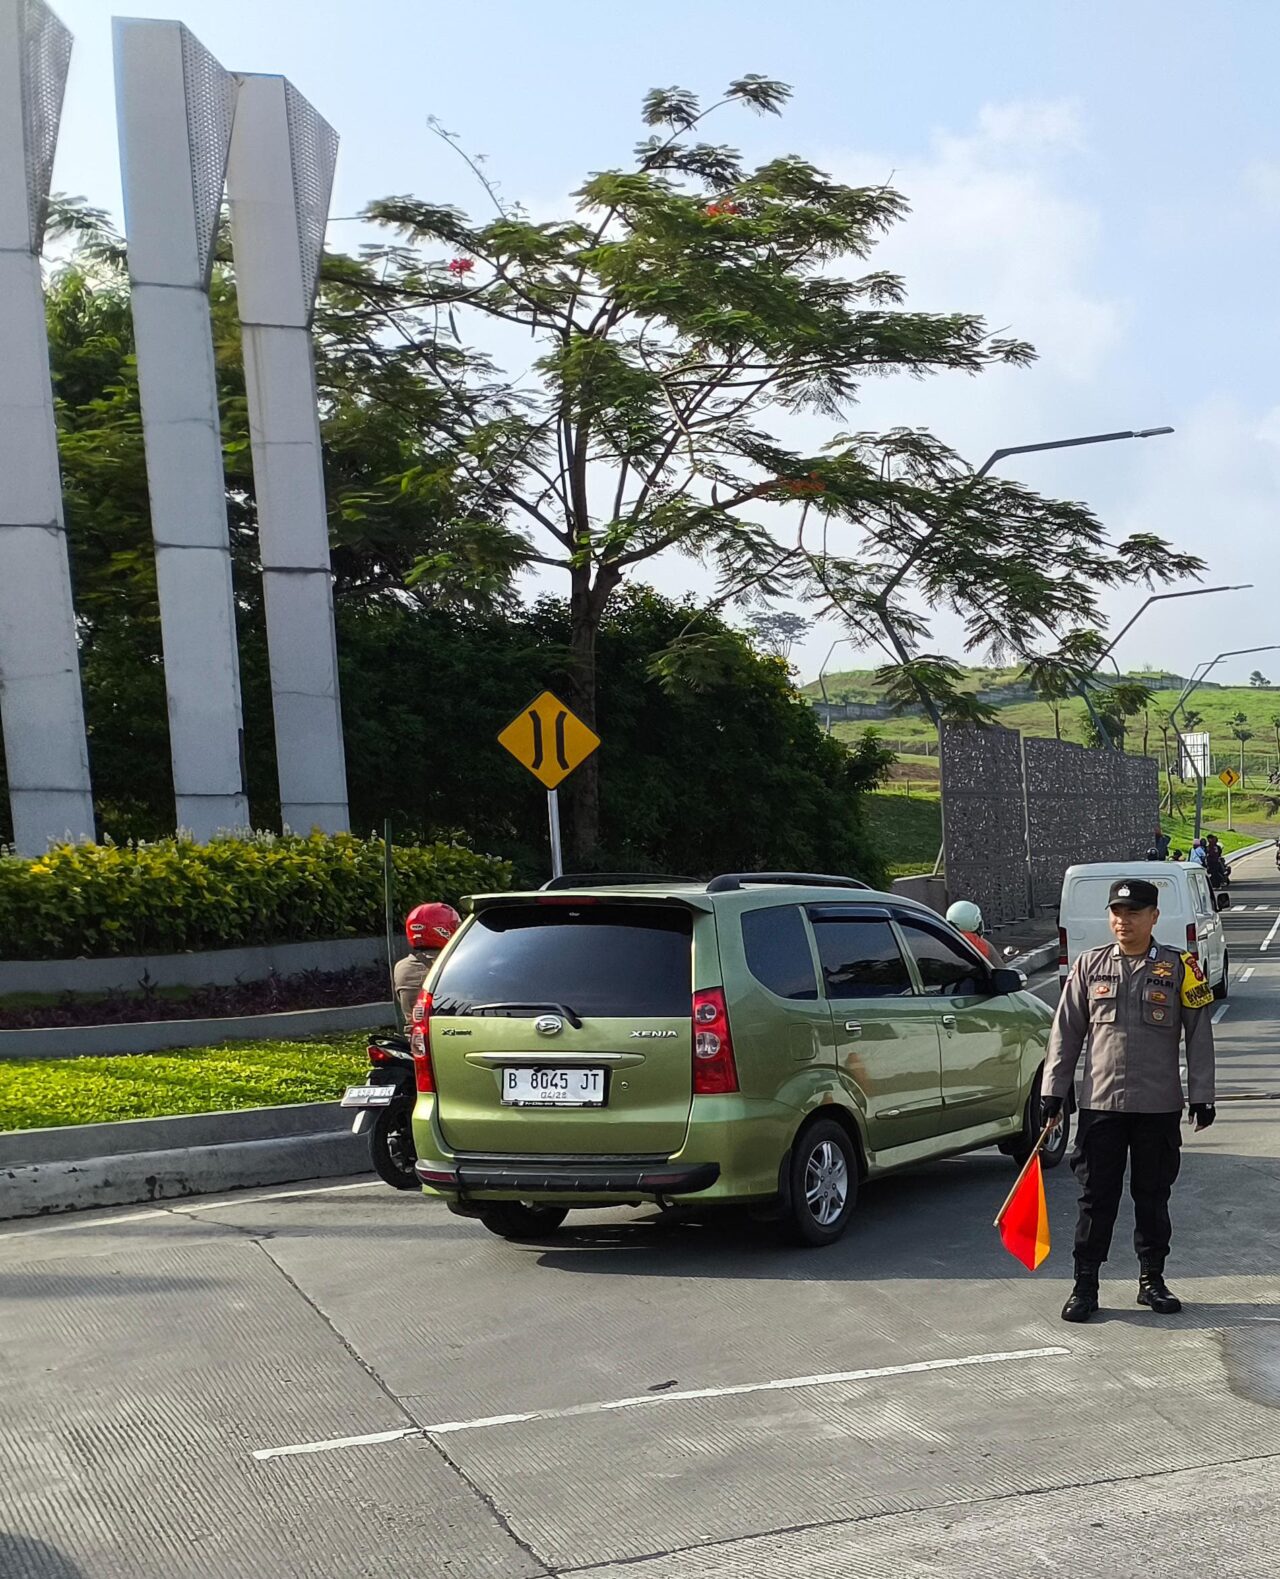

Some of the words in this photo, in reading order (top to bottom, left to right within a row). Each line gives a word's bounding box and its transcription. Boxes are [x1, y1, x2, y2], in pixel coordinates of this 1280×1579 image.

[1146, 978, 1174, 988] POLRI
[629, 1030, 678, 1038] XENIA
[508, 1072, 518, 1089] B
[530, 1072, 569, 1089] 8045
[580, 1073, 600, 1090] JT
[540, 1091, 567, 1099] 04/28
